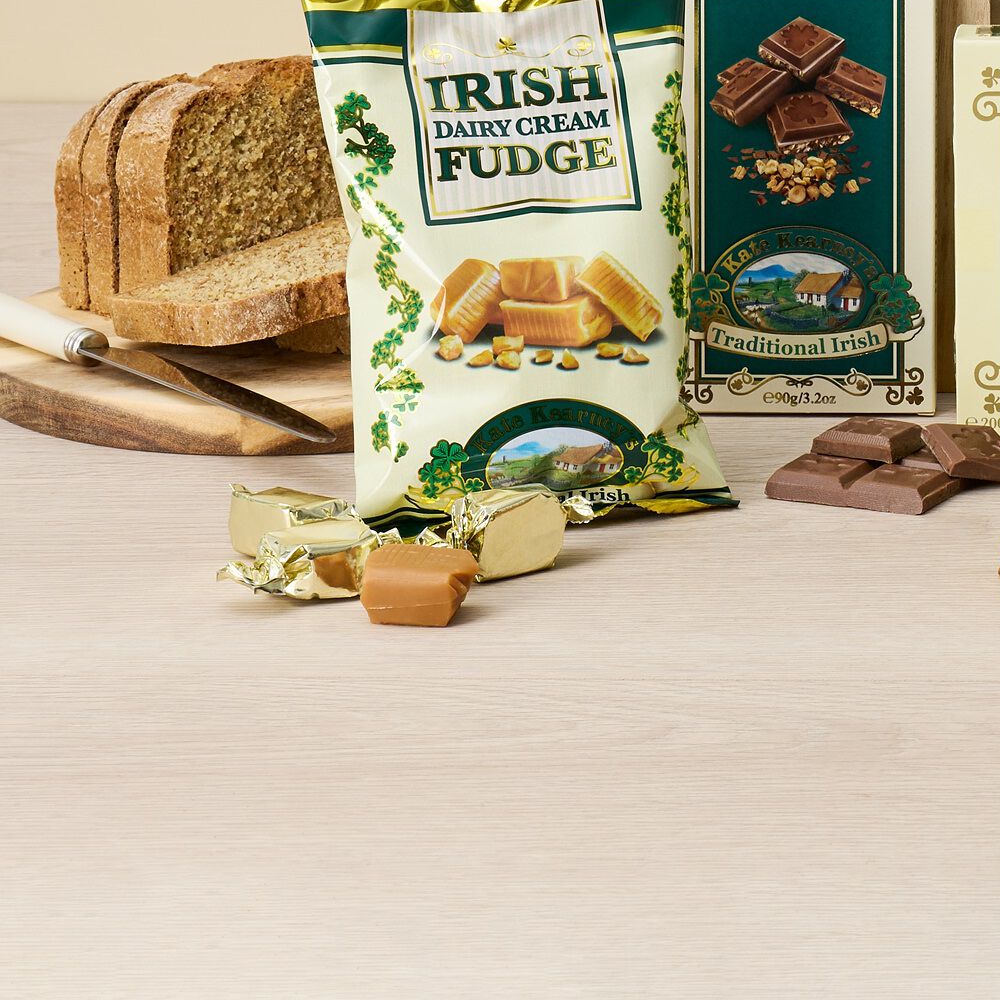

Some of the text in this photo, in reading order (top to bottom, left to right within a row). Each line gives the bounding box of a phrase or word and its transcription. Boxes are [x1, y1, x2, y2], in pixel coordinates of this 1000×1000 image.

[423, 63, 608, 113] IRISH
[433, 108, 611, 139] DAIRY CREAM
[434, 136, 618, 182] FUDGE
[721, 232, 879, 277] Kate Kearney's
[712, 327, 881, 356] Traditional Irish
[472, 414, 525, 454] Kate
[580, 487, 631, 502] Irish
